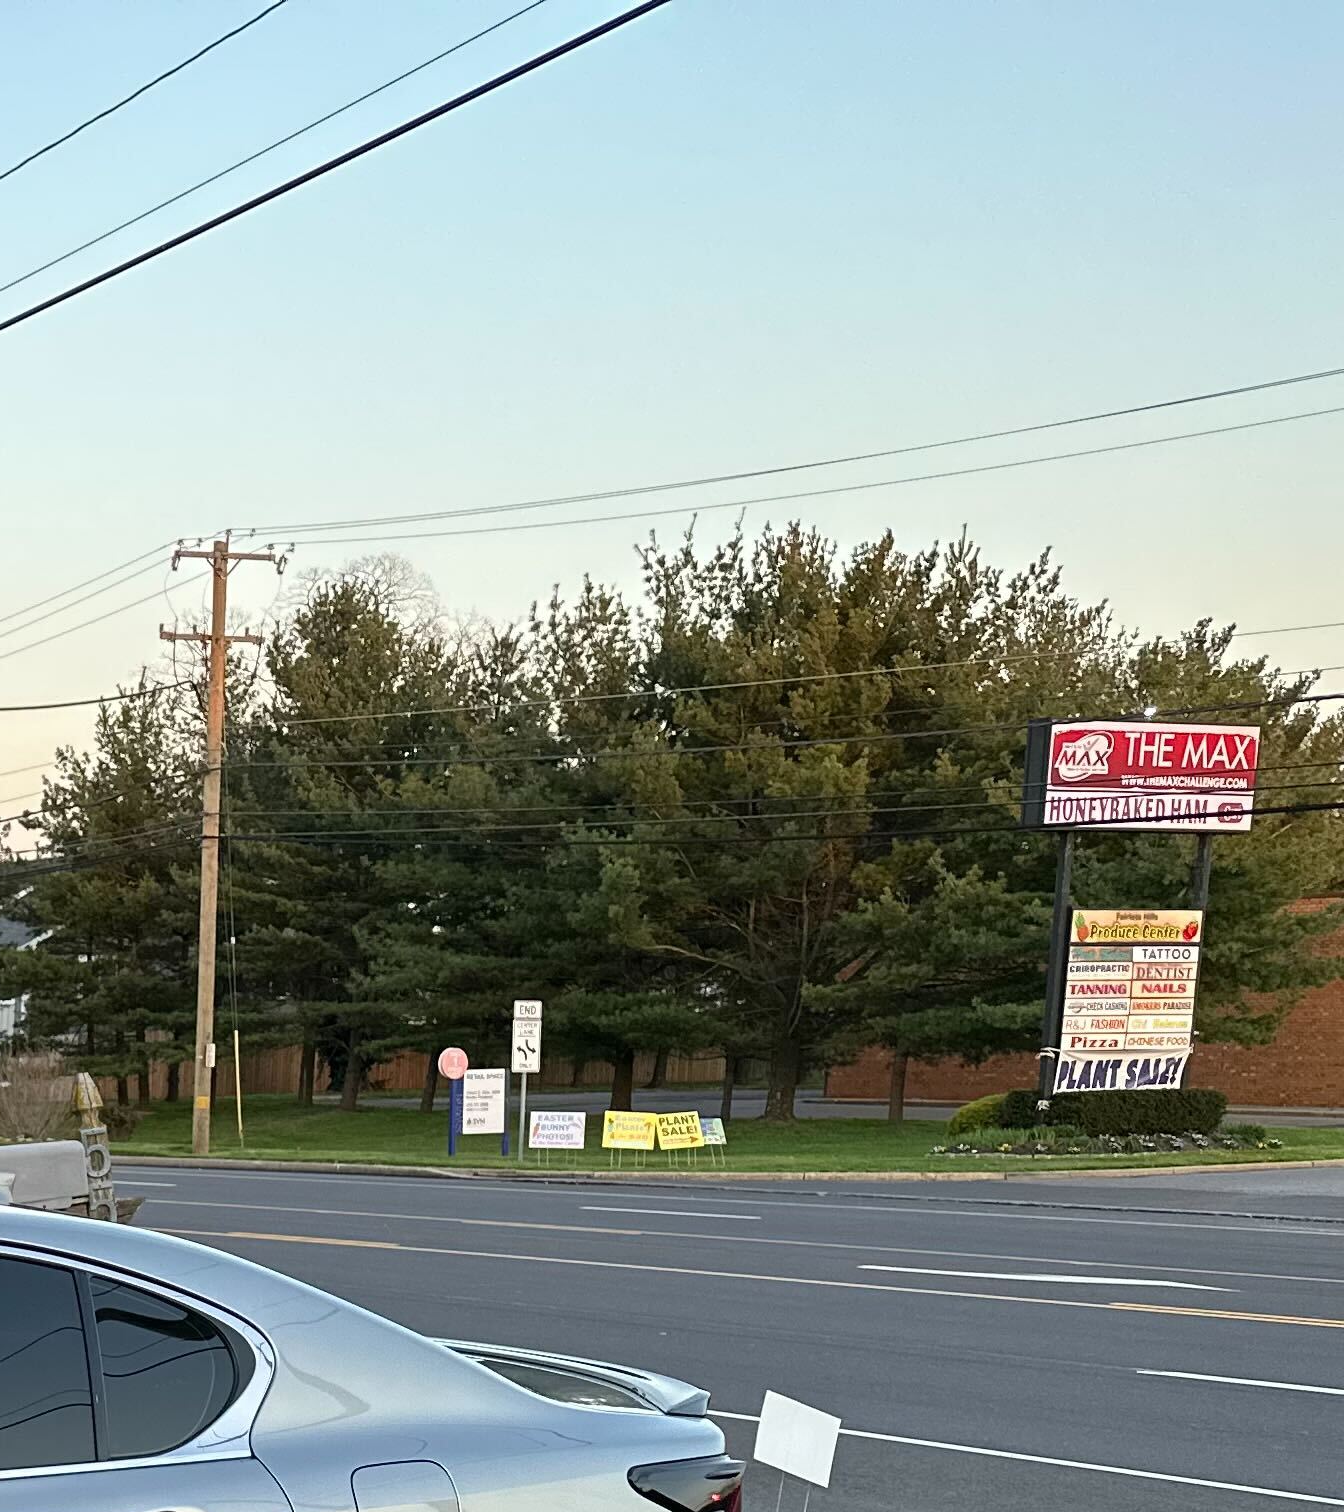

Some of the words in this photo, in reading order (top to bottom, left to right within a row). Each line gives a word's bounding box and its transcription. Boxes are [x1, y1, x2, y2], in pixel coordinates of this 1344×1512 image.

[1124, 732, 1176, 768] THE
[1180, 734, 1252, 770] MAX
[1058, 749, 1109, 767] MAX
[1049, 796, 1167, 823] HONEYBAKED
[1170, 798, 1209, 824] HAM
[1089, 923, 1140, 940] Produce
[1141, 923, 1181, 939] Center
[1141, 948, 1192, 960] TATTOO
[1069, 964, 1131, 973] CHIROPRACTIC
[1135, 967, 1193, 980] DENTIST
[1069, 984, 1128, 995] TANNING
[1141, 983, 1188, 994] NAILS
[519, 1004, 537, 1015] END
[1069, 1036, 1120, 1048] Pizza
[1127, 1036, 1165, 1046] CHINESE
[1166, 1036, 1189, 1046] FOOD
[1056, 1058, 1124, 1090] PLANT
[1124, 1056, 1184, 1089] SALE!
[537, 1114, 575, 1122] EASTER
[658, 1114, 696, 1126] PLANT
[540, 1123, 570, 1132] BUNNY
[662, 1124, 698, 1137] SALE!
